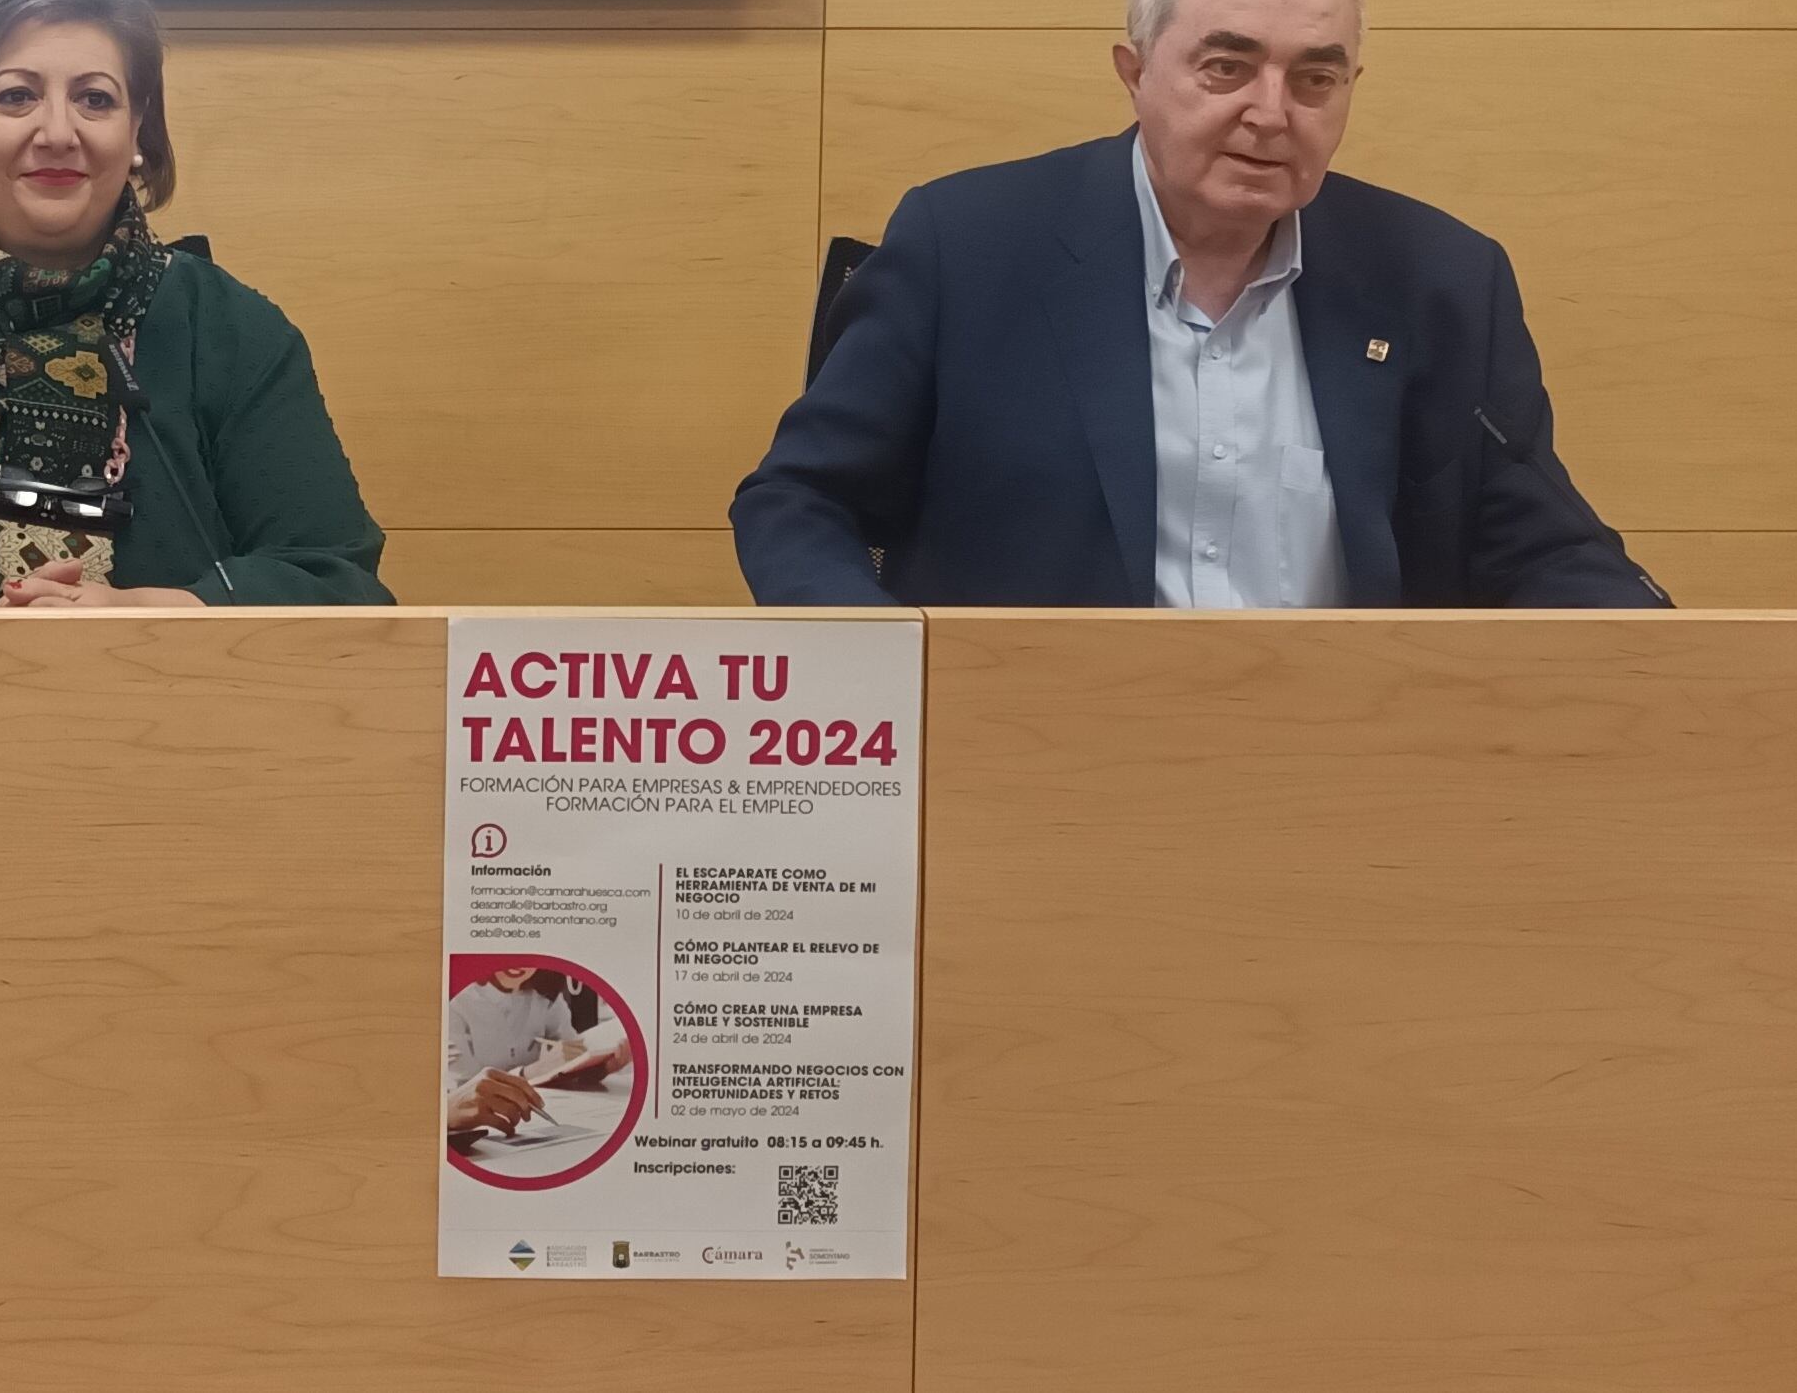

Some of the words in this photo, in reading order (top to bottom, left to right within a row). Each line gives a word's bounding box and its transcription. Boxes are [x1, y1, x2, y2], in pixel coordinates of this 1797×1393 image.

[463, 651, 698, 700] ACTIVA
[719, 654, 789, 701] TU
[462, 716, 726, 764] TALENTO
[749, 719, 897, 766] 2024
[460, 775, 573, 793] FORMACIÓN
[578, 777, 627, 792] PARA
[632, 778, 722, 795] EMPRESAS
[727, 779, 741, 795] &
[746, 780, 901, 796] EMPRENDEDORES
[546, 795, 659, 812] FORMACIÓN
[665, 797, 713, 813] PARA
[719, 798, 737, 814] EL
[742, 798, 813, 814] EMPLEO
[471, 864, 551, 876] Información
[634, 1135, 697, 1148] Webinar
[700, 1135, 759, 1151] gratuito
[767, 1136, 807, 1148] 08:15
[811, 1139, 821, 1148] a
[825, 1136, 866, 1148] 09:45
[870, 1136, 883, 1148] h.
[633, 1161, 735, 1176] Inscripciones:
